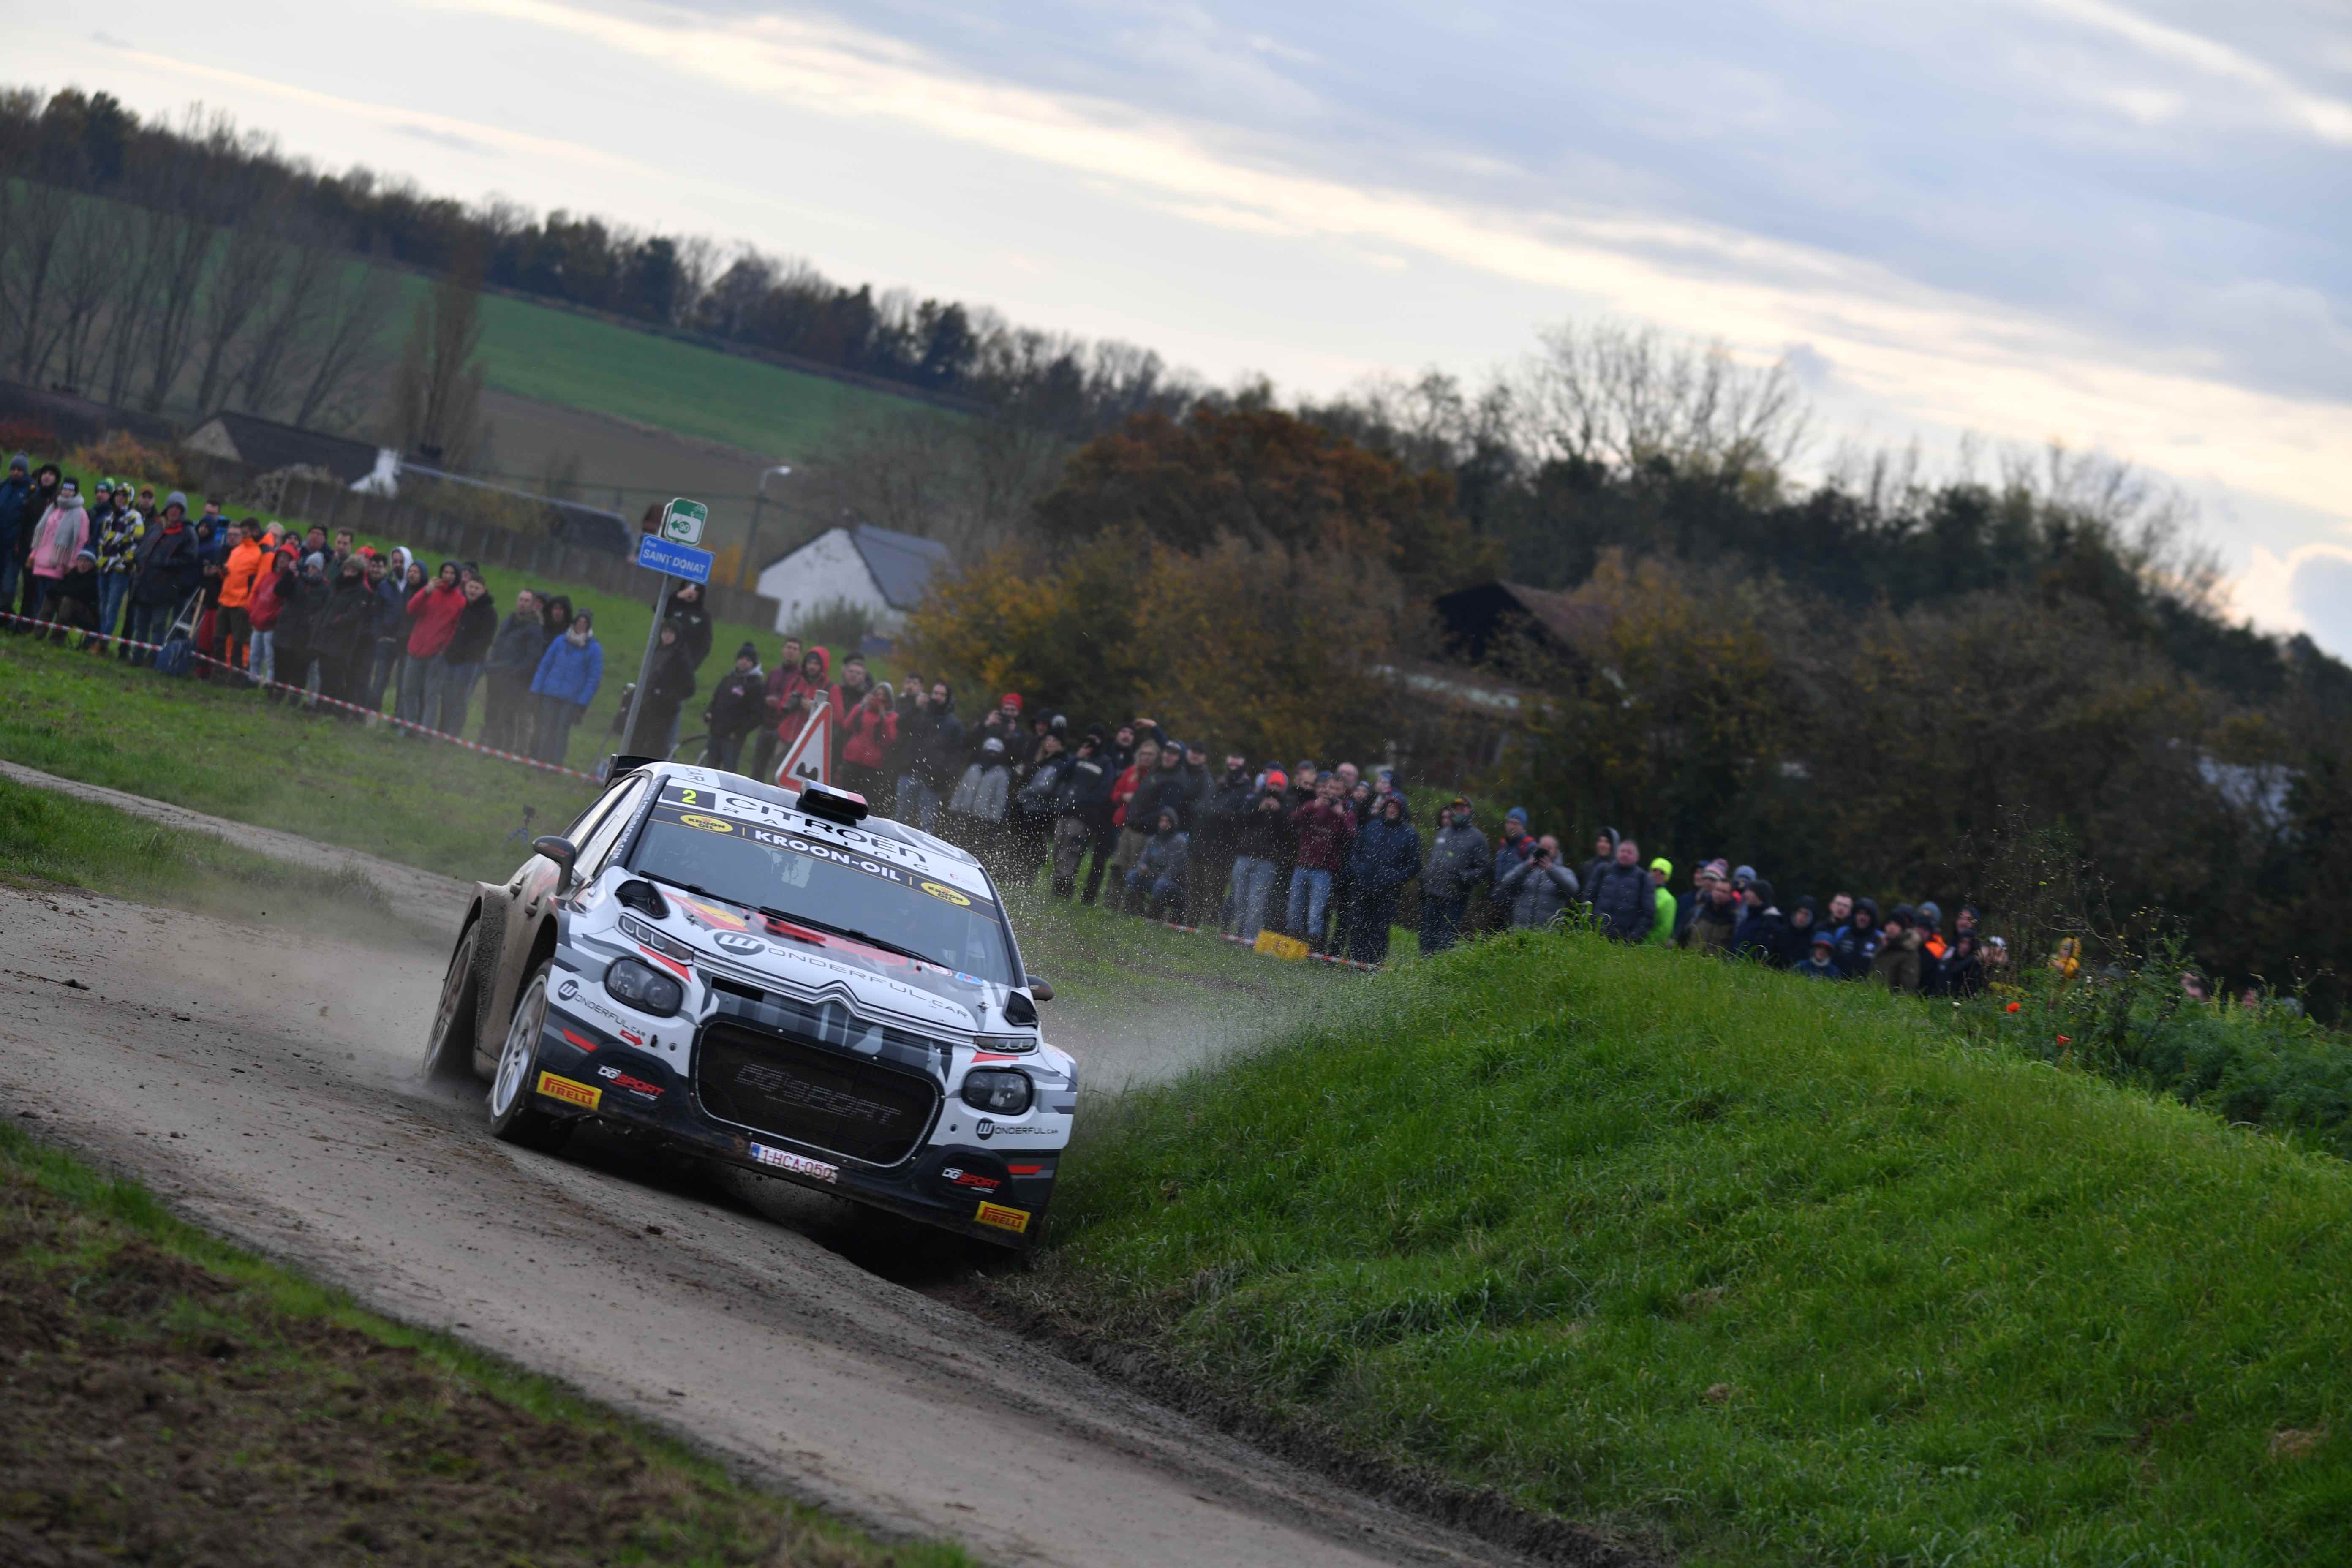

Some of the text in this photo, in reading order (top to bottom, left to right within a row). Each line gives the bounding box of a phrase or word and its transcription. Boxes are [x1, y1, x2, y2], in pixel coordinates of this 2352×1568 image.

[642, 549, 706, 574] SAINT DONAT
[681, 789, 697, 804] 2
[688, 818, 725, 829] KROON
[755, 830, 901, 882] KROON-OIL
[928, 885, 964, 902] KROON
[937, 893, 953, 902] OIL
[544, 1076, 595, 1105] PIRELLI
[763, 1149, 833, 1179] 1-HCA-050
[980, 1206, 1025, 1229] PIRELLI
